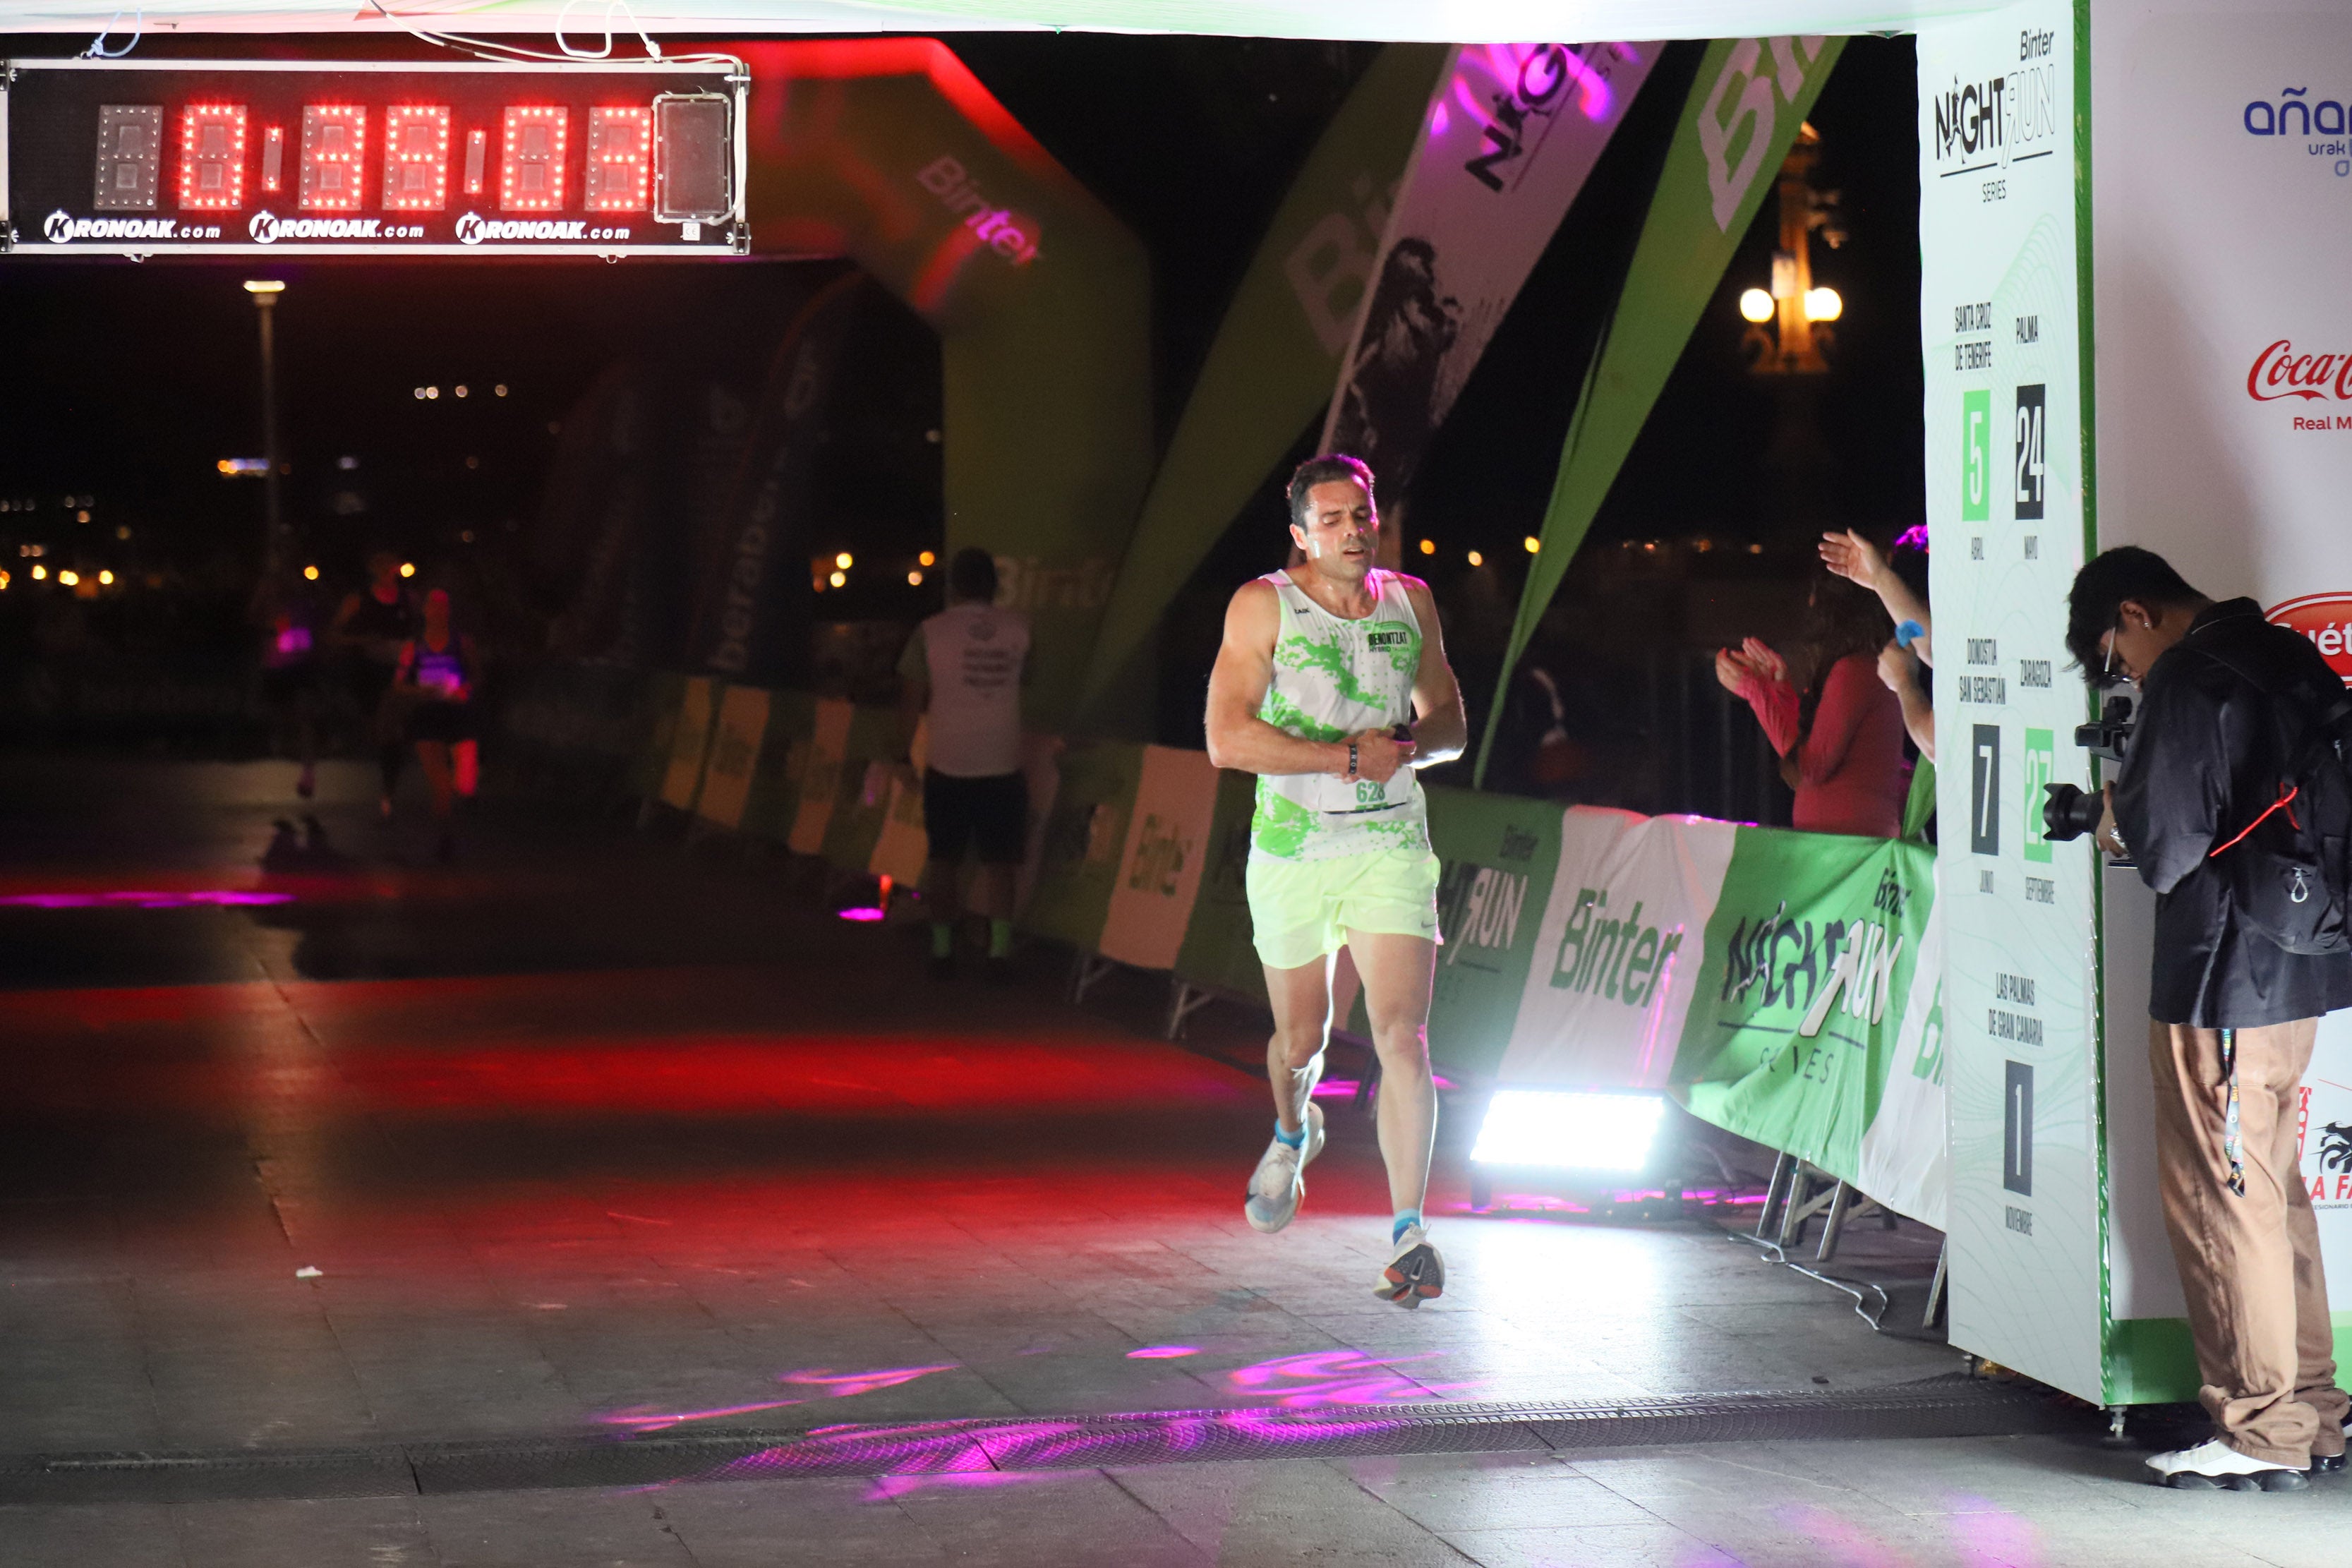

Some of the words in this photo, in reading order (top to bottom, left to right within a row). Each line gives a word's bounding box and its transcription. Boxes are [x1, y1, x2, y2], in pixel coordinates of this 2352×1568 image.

[2020, 28, 2054, 61] Binter
[2243, 86, 2352, 135] aña
[2308, 140, 2346, 155] urak
[1982, 179, 2006, 203] SERIES
[1955, 304, 1974, 333] SANTA
[1976, 301, 1991, 330] CRUZ
[2016, 315, 2039, 344] PALMA
[1955, 344, 1962, 370] DE
[1965, 340, 1991, 370] TENERIFE
[2293, 416, 2332, 430] Real
[1969, 411, 1983, 506] 5
[2016, 406, 2044, 502] 24
[1967, 638, 1998, 665] DONOSTIA
[1959, 675, 1971, 702] SAN
[2020, 659, 2051, 688] ZARAGOZA
[1979, 745, 1993, 838] 7
[1549, 887, 1683, 1008] Binter
[1996, 972, 2008, 1000] LAS
[2010, 975, 2035, 1007] PALMAS
[1989, 1008, 1996, 1037] DE
[1998, 1010, 2015, 1041] GRAN
[2017, 1014, 2044, 1047] CANARIA
